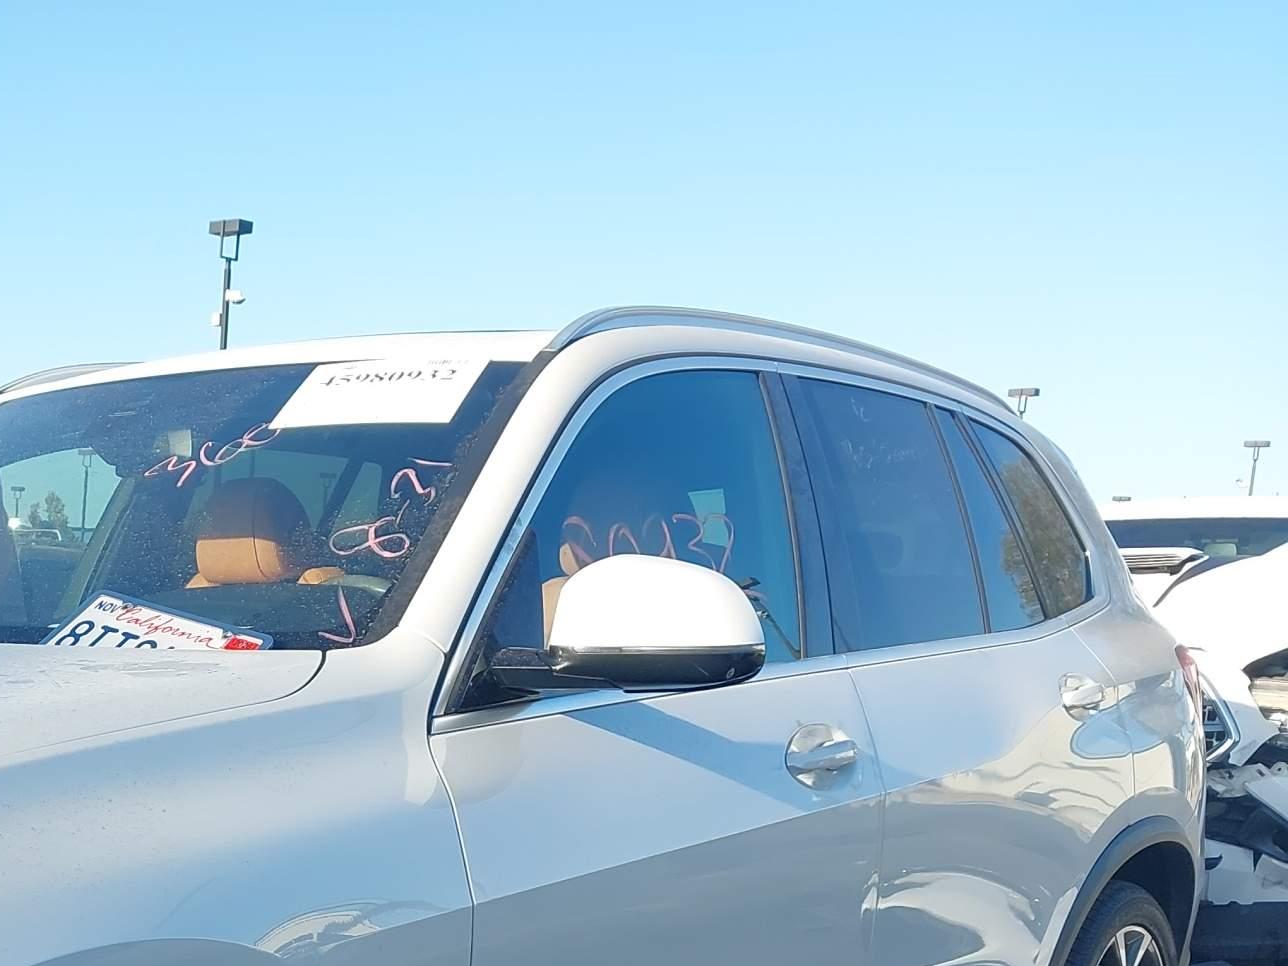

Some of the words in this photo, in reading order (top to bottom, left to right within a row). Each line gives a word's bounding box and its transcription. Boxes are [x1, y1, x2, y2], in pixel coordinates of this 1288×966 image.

[319, 368, 457, 387] 45980932
[94, 600, 122, 614] NOV
[54, 620, 176, 650] 8TT
[115, 606, 220, 649] California
